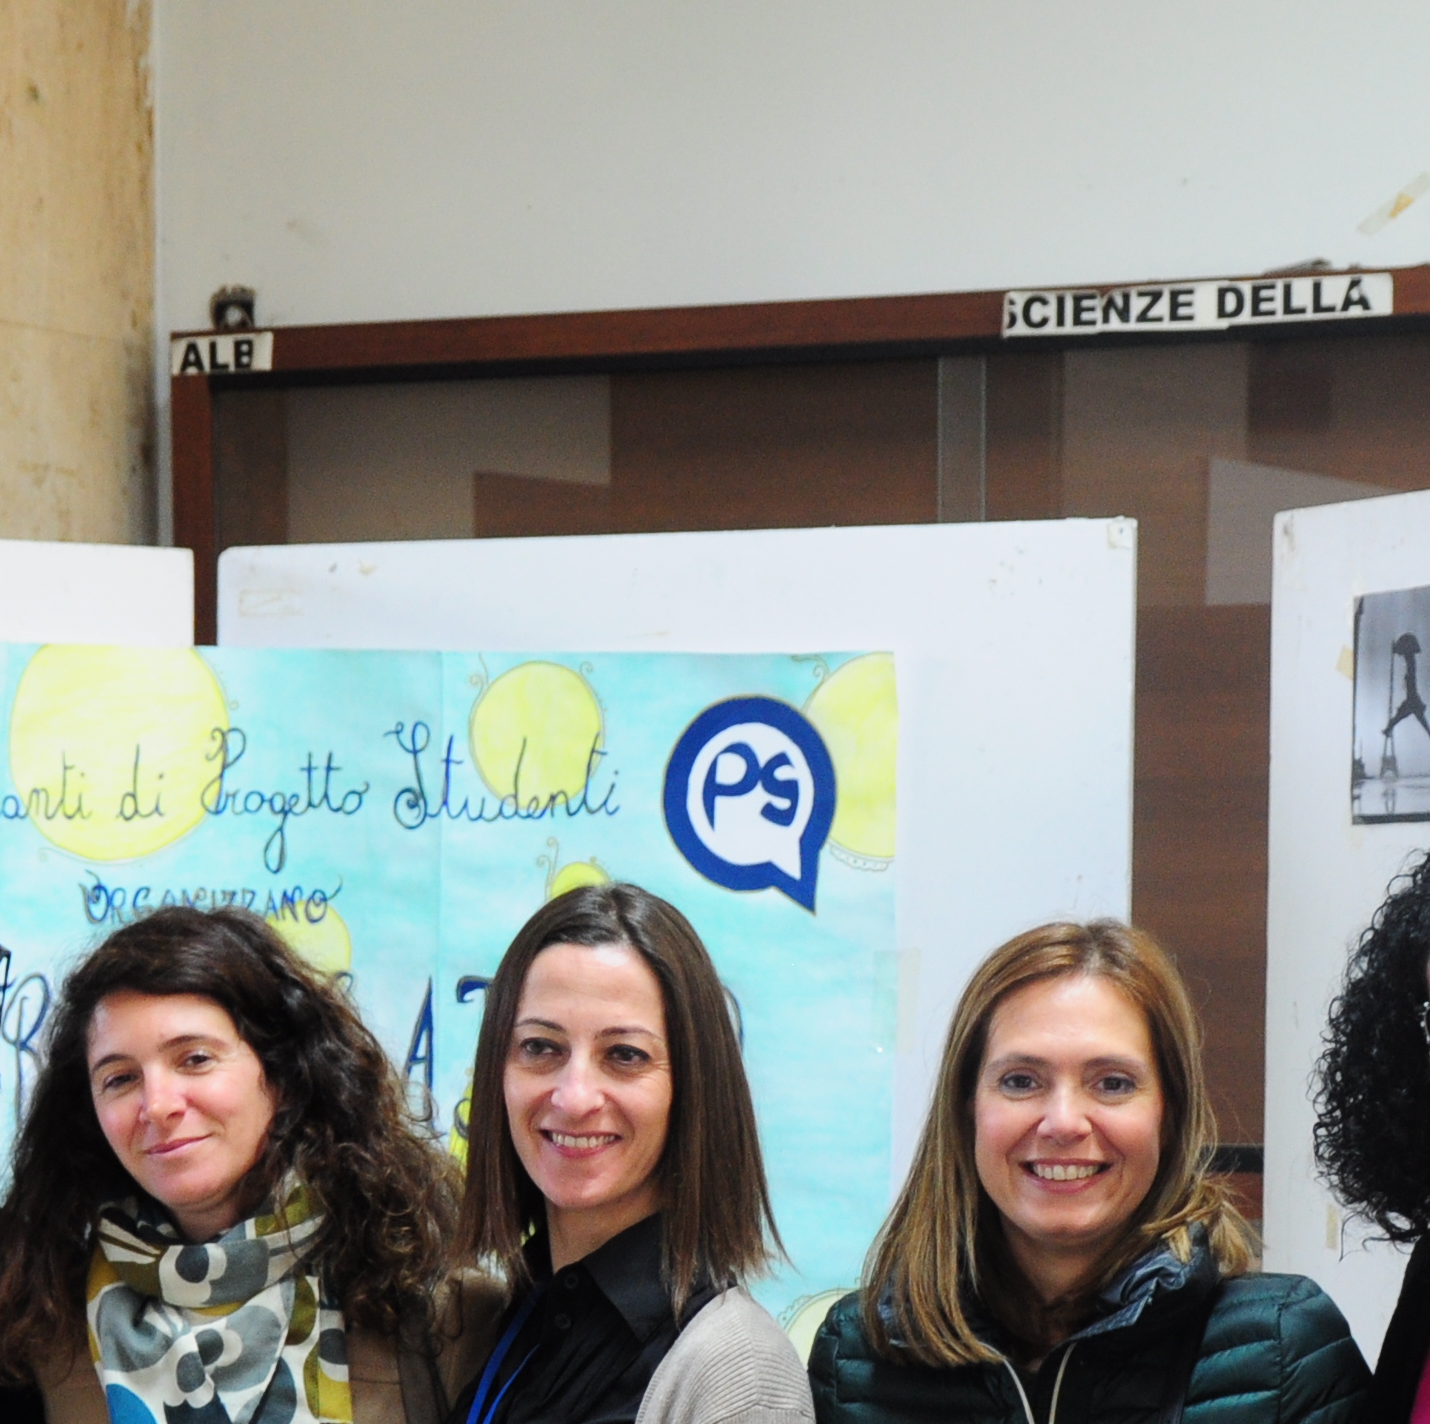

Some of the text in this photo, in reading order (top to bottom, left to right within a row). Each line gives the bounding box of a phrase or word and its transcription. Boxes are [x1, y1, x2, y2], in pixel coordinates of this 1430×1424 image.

[1005, 277, 1371, 329] SCIENZE DELLA
[180, 339, 253, 372] ALB
[115, 743, 167, 823] di
[200, 726, 370, 873] Progetto
[383, 719, 621, 829] Studenti
